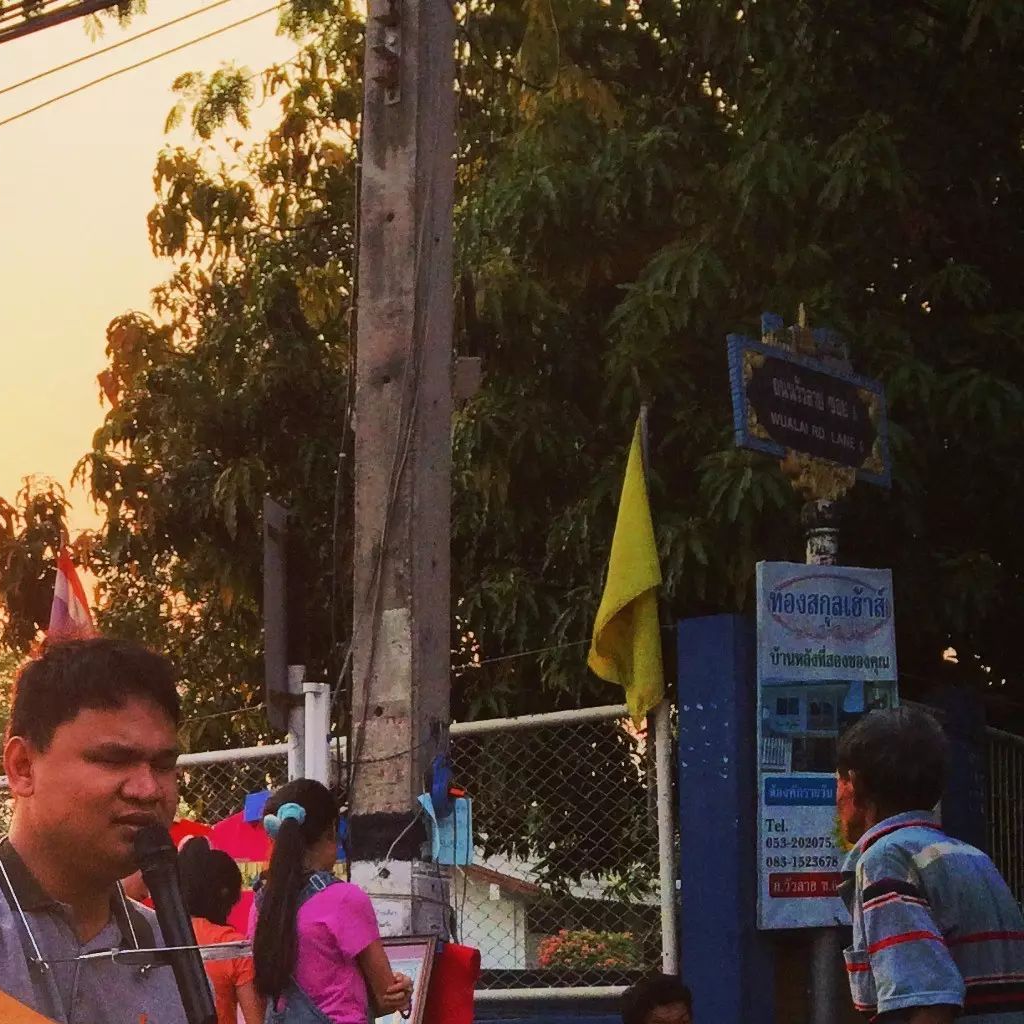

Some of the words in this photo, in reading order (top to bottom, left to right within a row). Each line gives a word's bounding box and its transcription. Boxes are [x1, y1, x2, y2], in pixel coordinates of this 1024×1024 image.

[770, 411, 809, 435] WUALAI
[769, 586, 886, 627] ทองสกุลเฮ้าส์
[769, 645, 890, 675] บ้านหลังที่สองของคุณ
[766, 818, 788, 833] Tel.
